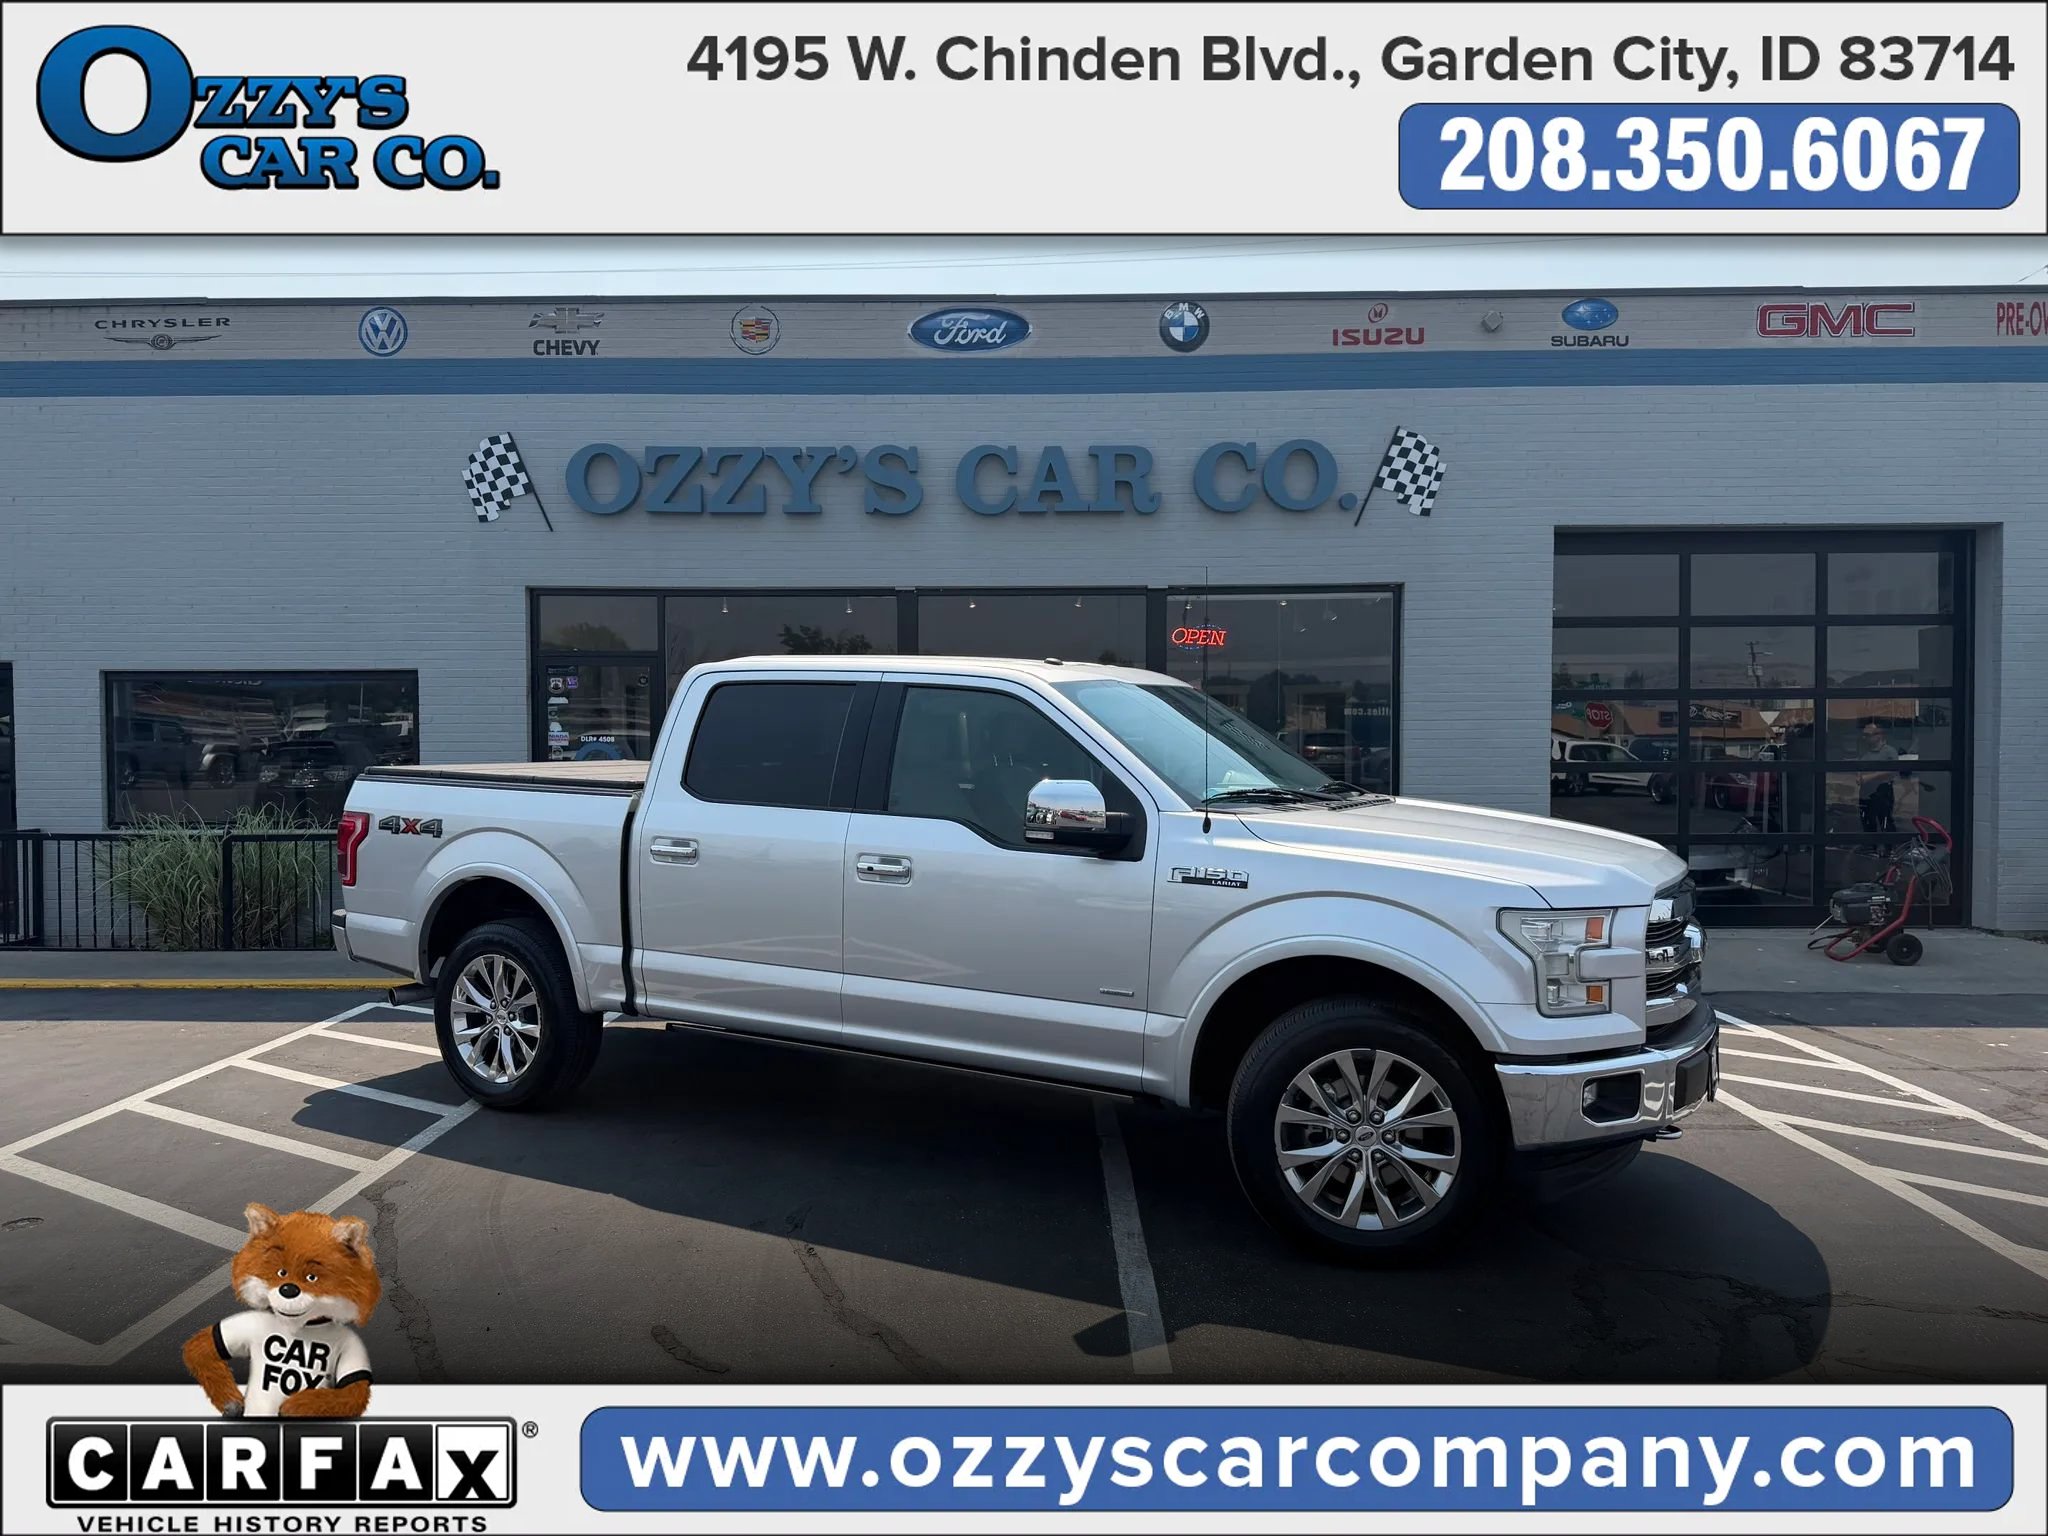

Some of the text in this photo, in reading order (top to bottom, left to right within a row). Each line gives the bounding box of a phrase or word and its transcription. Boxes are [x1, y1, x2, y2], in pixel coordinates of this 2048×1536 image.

[1164, 303, 1205, 319] BMW
[1757, 302, 1914, 338] GMC
[94, 317, 231, 329] CHRYSLER
[934, 312, 1008, 345] Ford
[1333, 328, 1425, 346] ISUZU
[1551, 335, 1629, 347] SUBARU
[533, 340, 600, 355] CHEVY
[564, 438, 1359, 516] OZZY'S CAR CO.
[1171, 627, 1227, 646] OPEN
